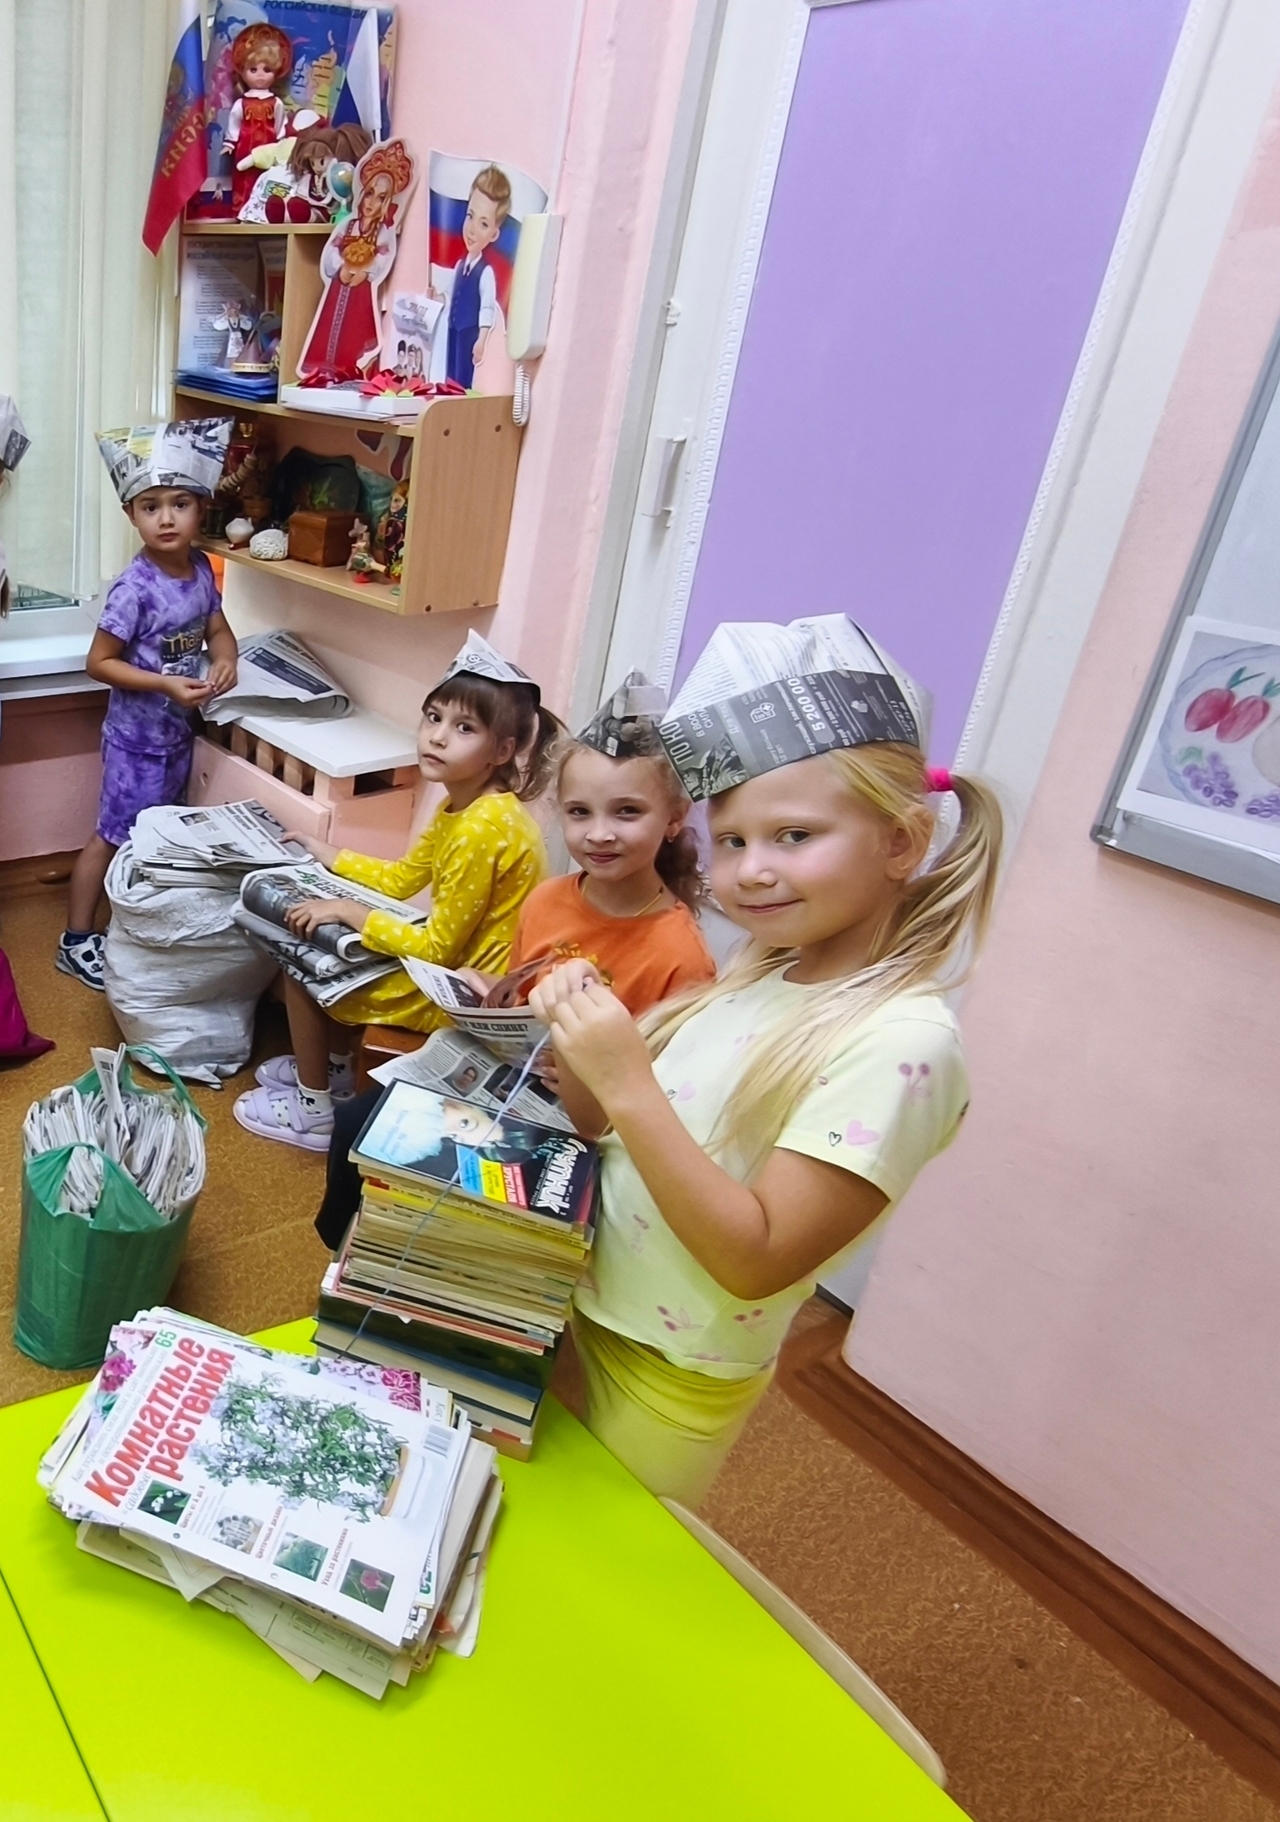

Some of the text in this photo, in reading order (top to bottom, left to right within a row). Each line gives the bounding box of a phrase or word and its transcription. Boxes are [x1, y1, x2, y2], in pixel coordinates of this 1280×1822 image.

[797, 694, 820, 722] 200
[695, 729, 705, 738] В
[811, 720, 825, 732] 5
[658, 720, 695, 765] ПО КО
[158, 1329, 176, 1348] 65
[84, 1337, 206, 1507] Комнатные
[146, 1347, 236, 1482] растения
[127, 1472, 152, 1511] садовые
[320, 1569, 333, 1586] Уход
